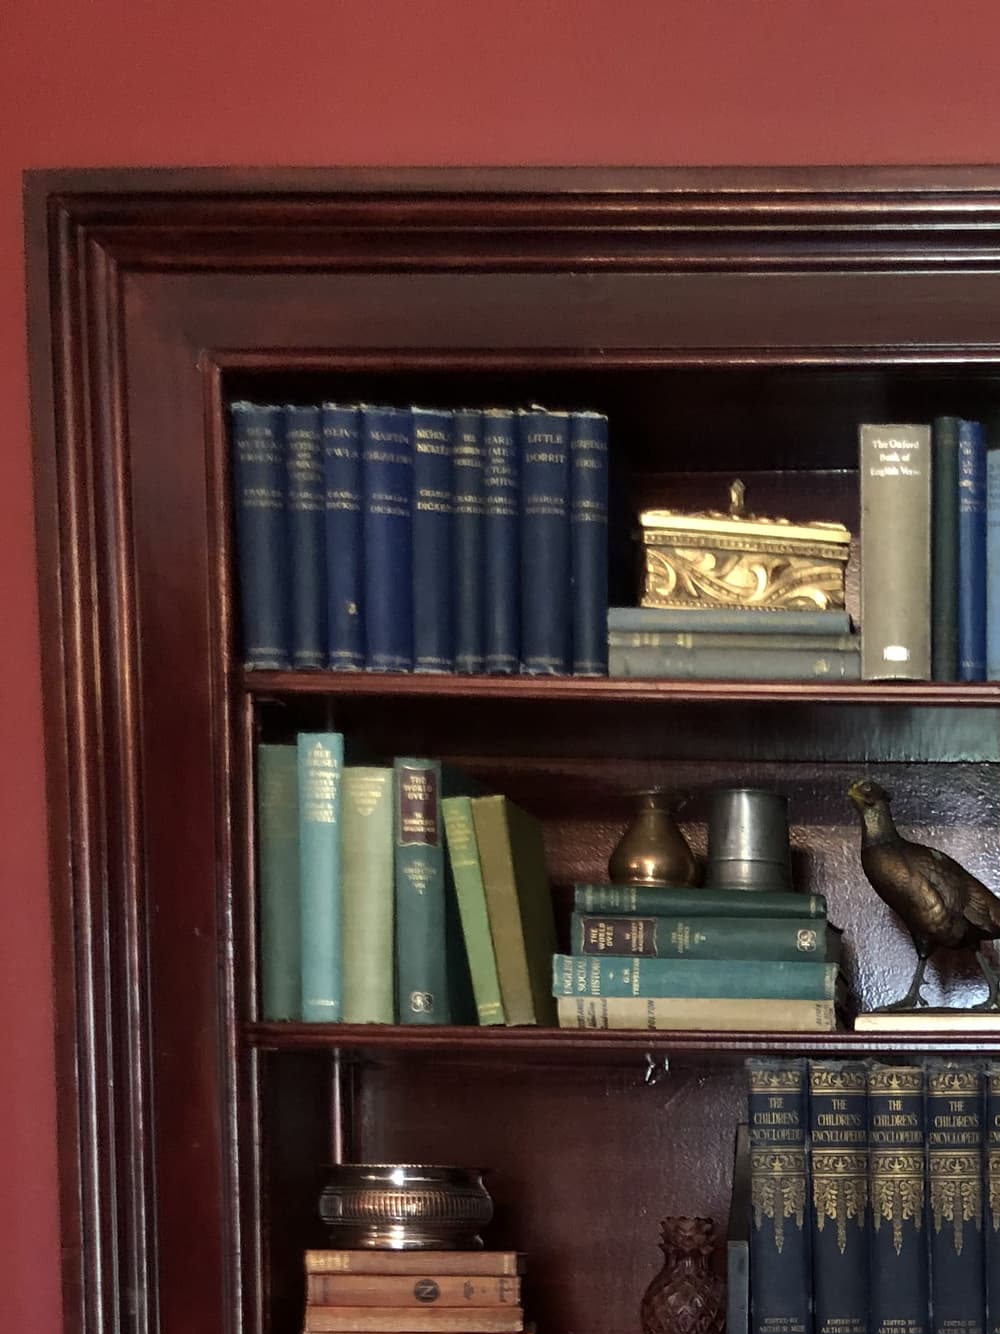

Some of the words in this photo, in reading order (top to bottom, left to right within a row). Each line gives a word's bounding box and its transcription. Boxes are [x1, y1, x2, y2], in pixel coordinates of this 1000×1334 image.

[528, 434, 563, 445] LITTLE
[872, 440, 888, 449] The
[889, 439, 919, 449] Oxford
[526, 452, 567, 464] DORRIT
[901, 453, 911, 462] of
[870, 467, 899, 477] English
[606, 926, 614, 947] OVER
[563, 958, 573, 995] ENGLISH
[577, 959, 587, 993] SOCIAL
[591, 958, 600, 996] HISTORY
[768, 1097, 784, 1109] THE
[831, 1098, 848, 1111] THE
[888, 1099, 904, 1112] THE
[949, 1100, 965, 1113] THE
[753, 1110, 800, 1125] CHILDREN'S
[817, 1113, 862, 1127] CHILDREN'S
[873, 1112, 919, 1127] CHILDREN'S
[934, 1114, 979, 1129] CHILDREN'S
